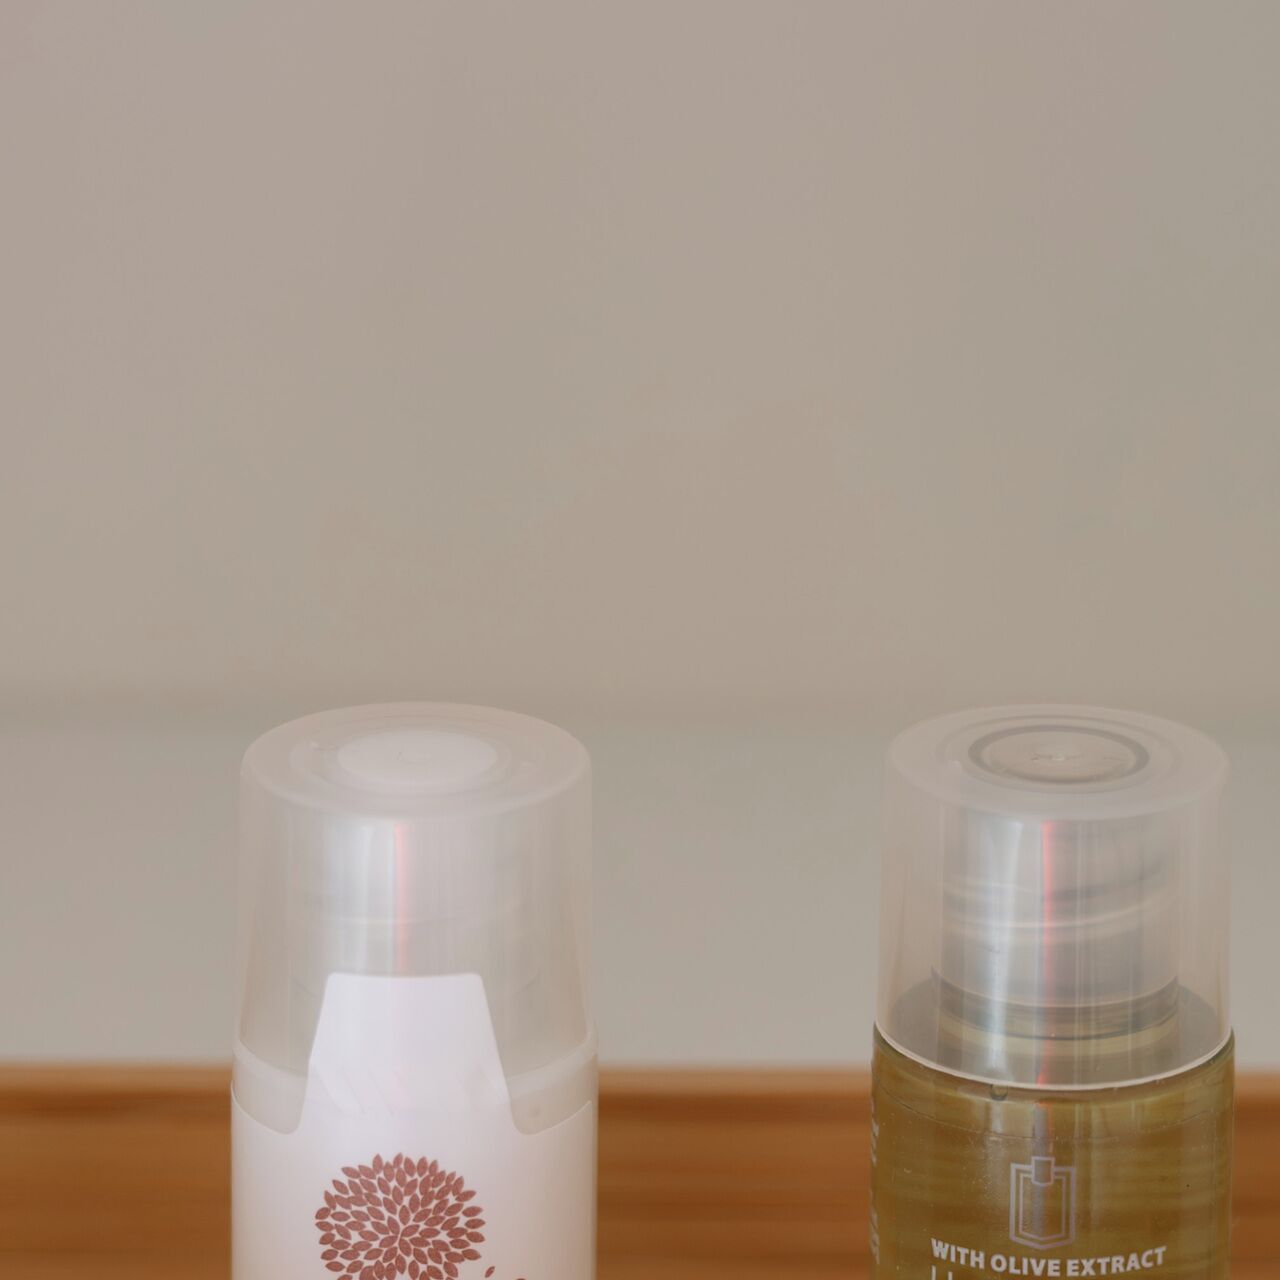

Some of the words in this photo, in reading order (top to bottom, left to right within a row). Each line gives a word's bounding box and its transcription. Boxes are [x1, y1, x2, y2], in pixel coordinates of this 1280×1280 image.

[931, 1238, 984, 1269] WITH
[990, 1252, 1060, 1277] OLIVE
[1066, 1246, 1166, 1277] EXTRACT
